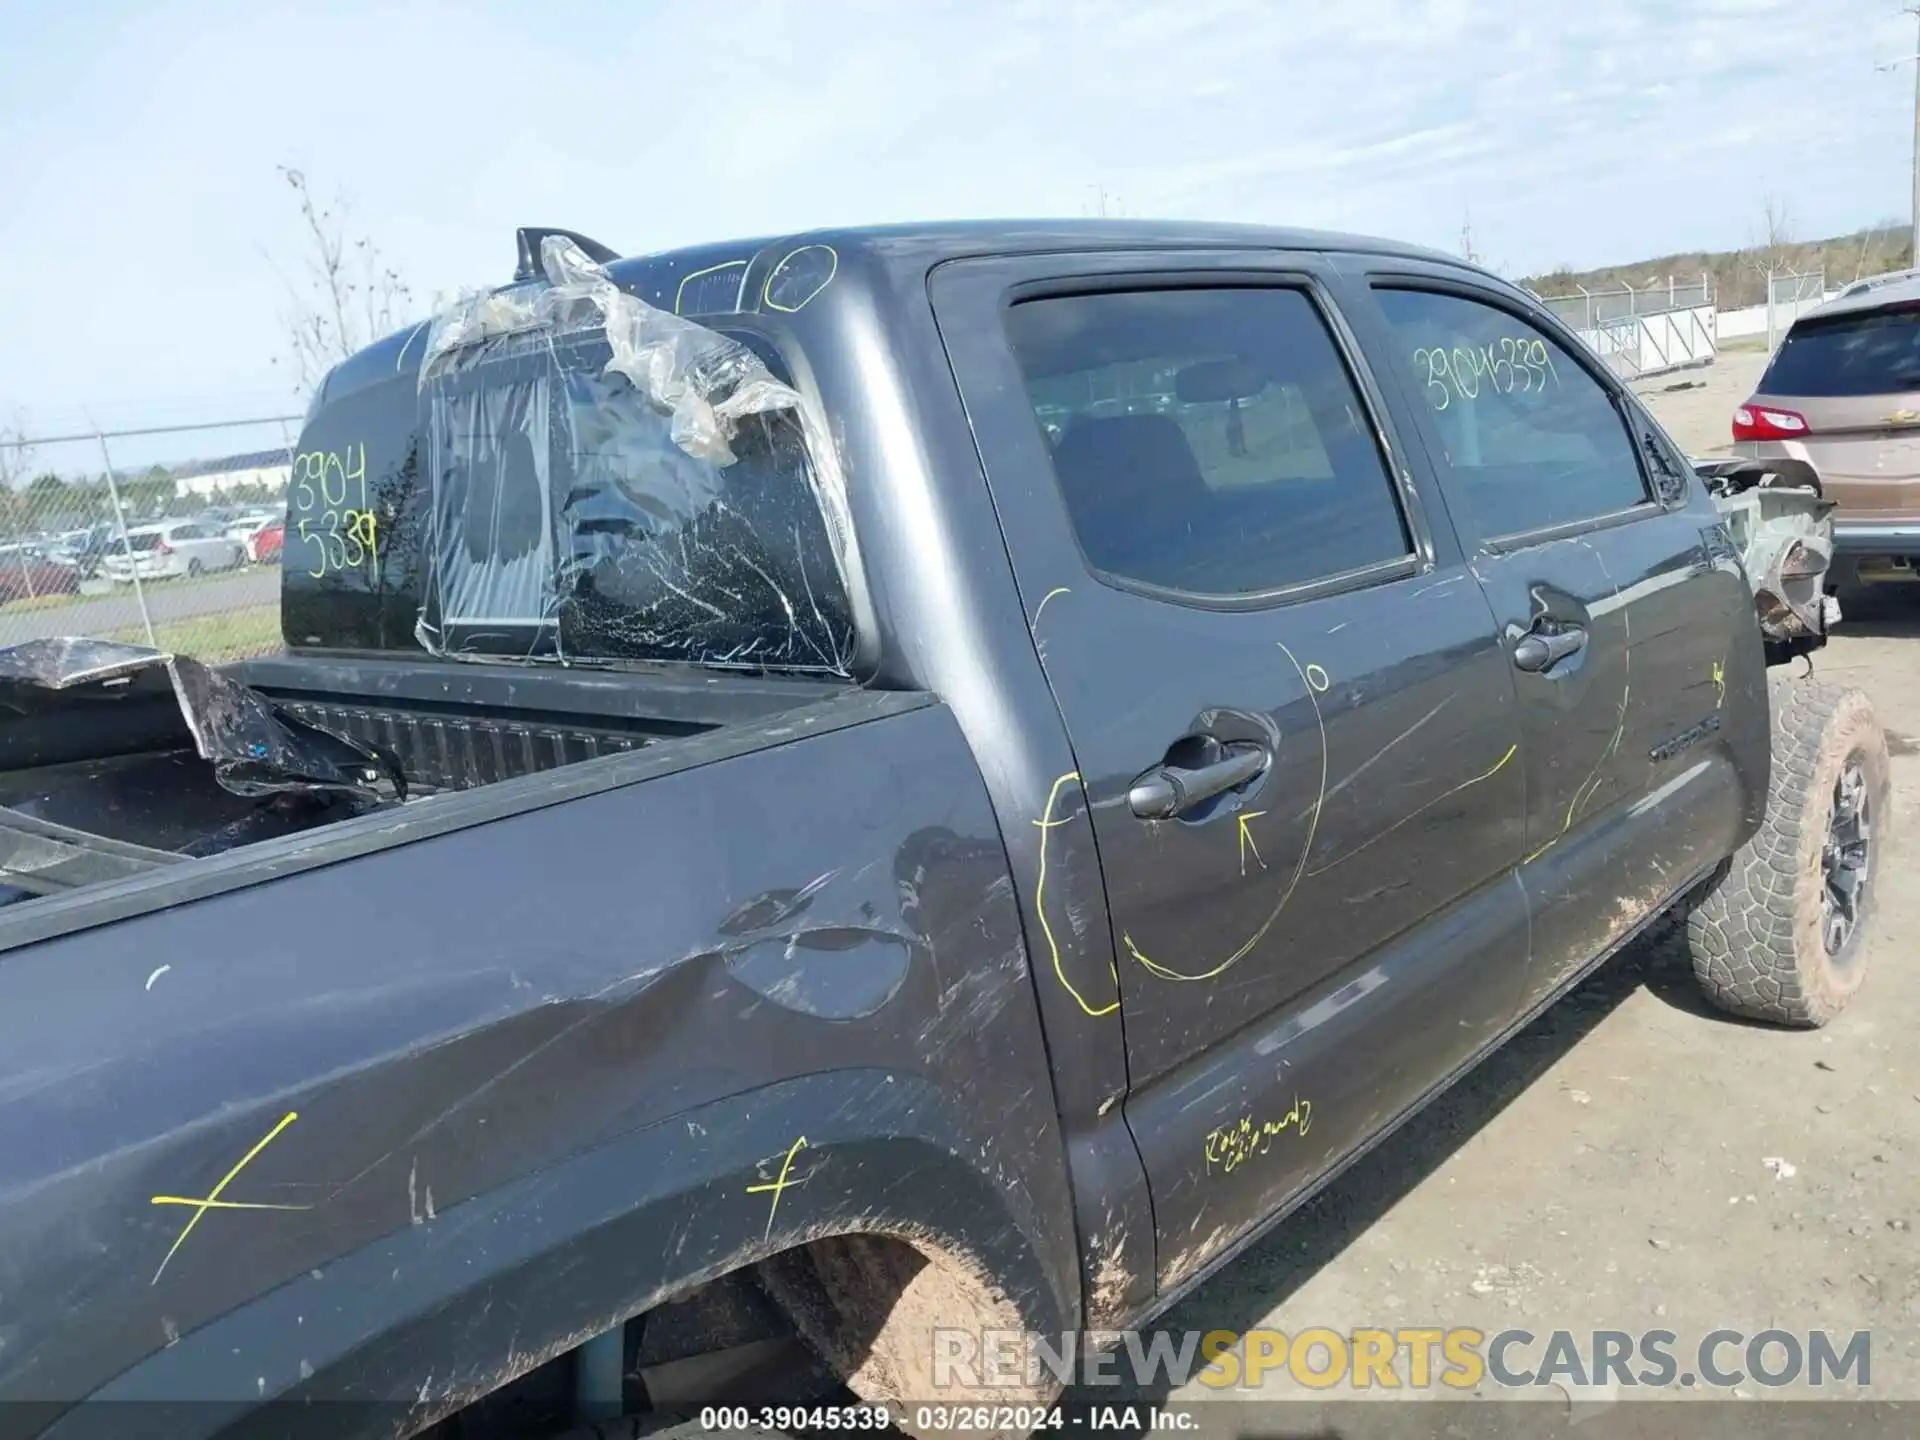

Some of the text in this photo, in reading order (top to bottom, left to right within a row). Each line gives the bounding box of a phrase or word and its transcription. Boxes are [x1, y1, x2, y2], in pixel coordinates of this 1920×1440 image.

[1413, 337, 1561, 411] 39045339
[294, 441, 366, 513] 3904
[298, 508, 378, 580] 5339
